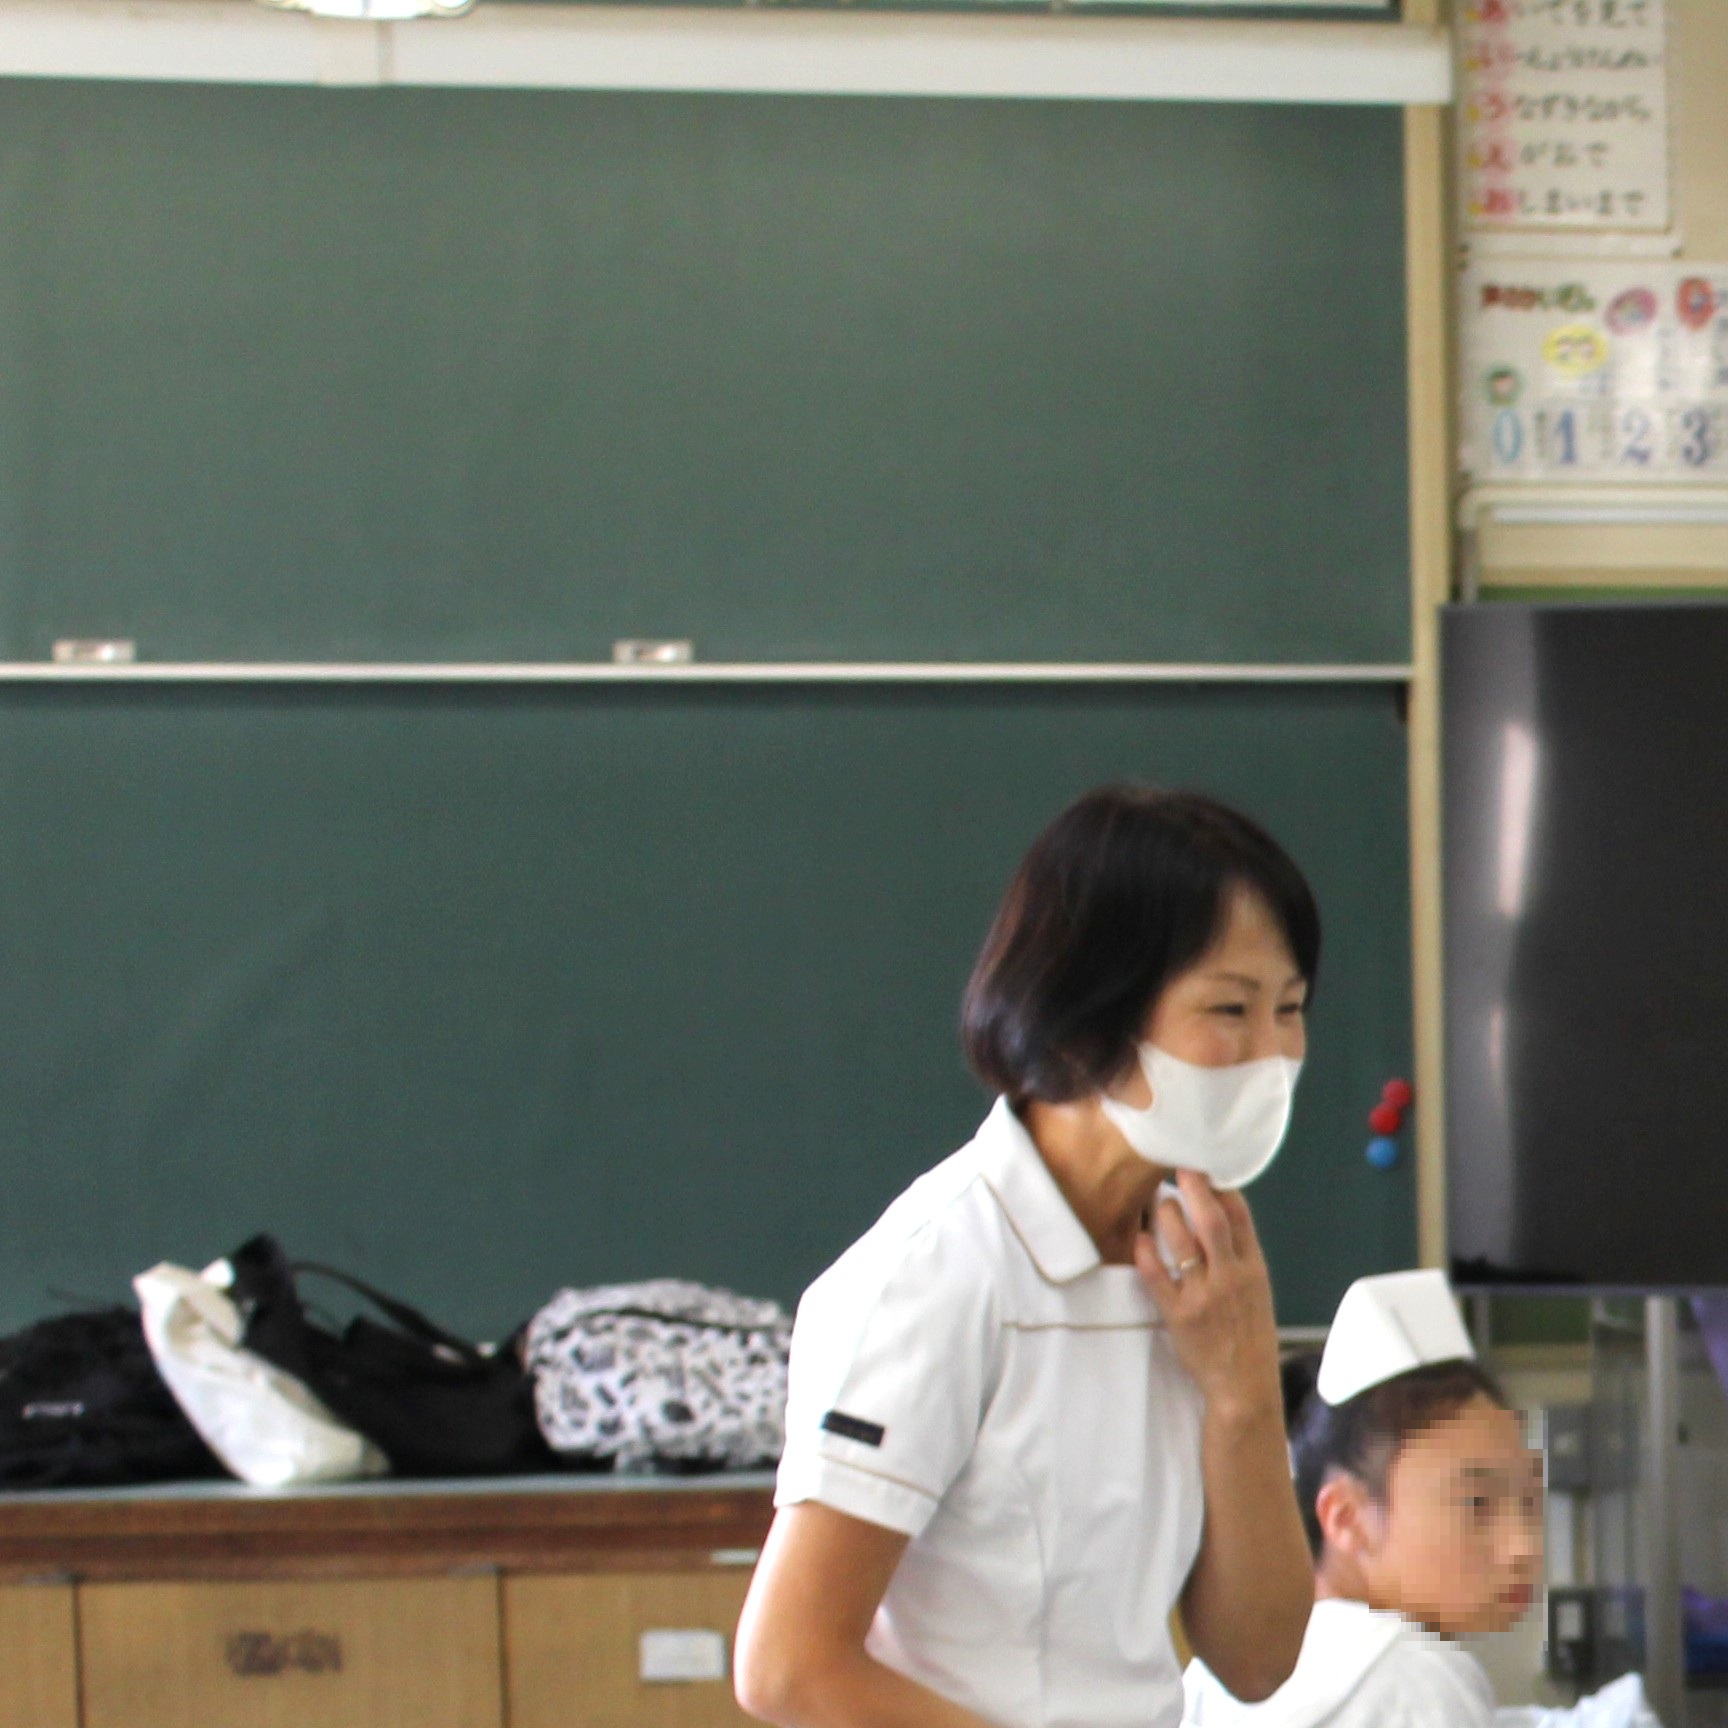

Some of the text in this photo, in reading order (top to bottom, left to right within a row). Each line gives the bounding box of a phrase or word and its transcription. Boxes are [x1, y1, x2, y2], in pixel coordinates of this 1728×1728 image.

[1494, 407, 1523, 464] 0
[1553, 407, 1577, 465] 1
[1620, 408, 1652, 464] 2
[1682, 407, 1709, 467] 3
